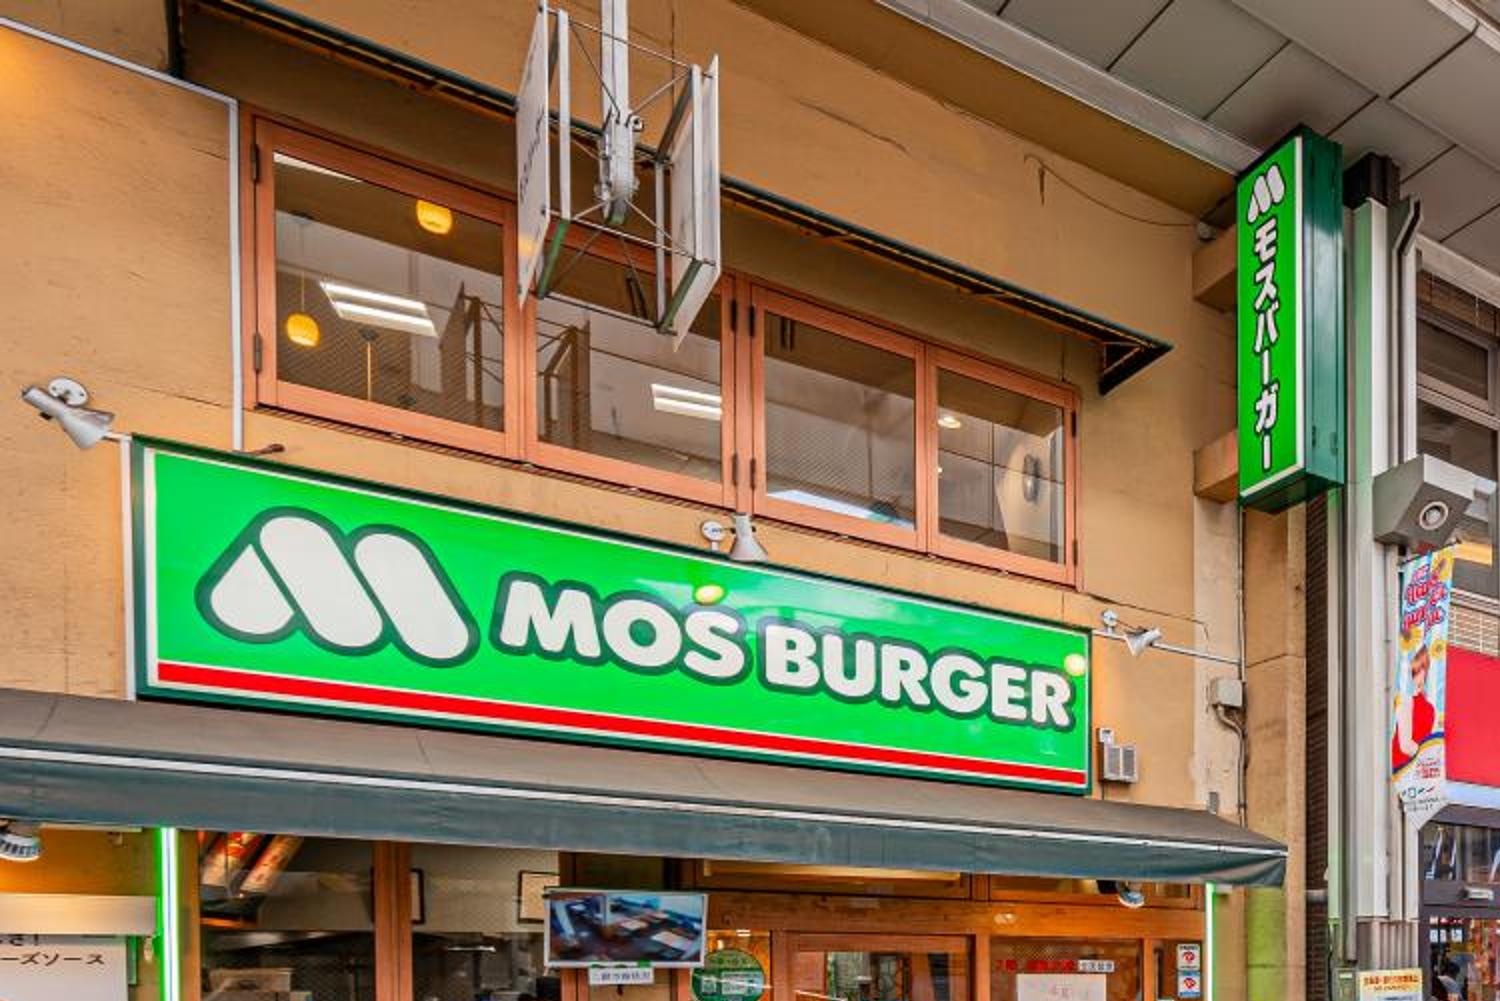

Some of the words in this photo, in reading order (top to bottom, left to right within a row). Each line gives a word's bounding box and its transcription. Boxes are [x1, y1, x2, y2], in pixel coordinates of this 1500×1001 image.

[1252, 217, 1280, 471] モスバーガー
[499, 580, 745, 679] MOS
[764, 624, 1072, 727] BURGER
